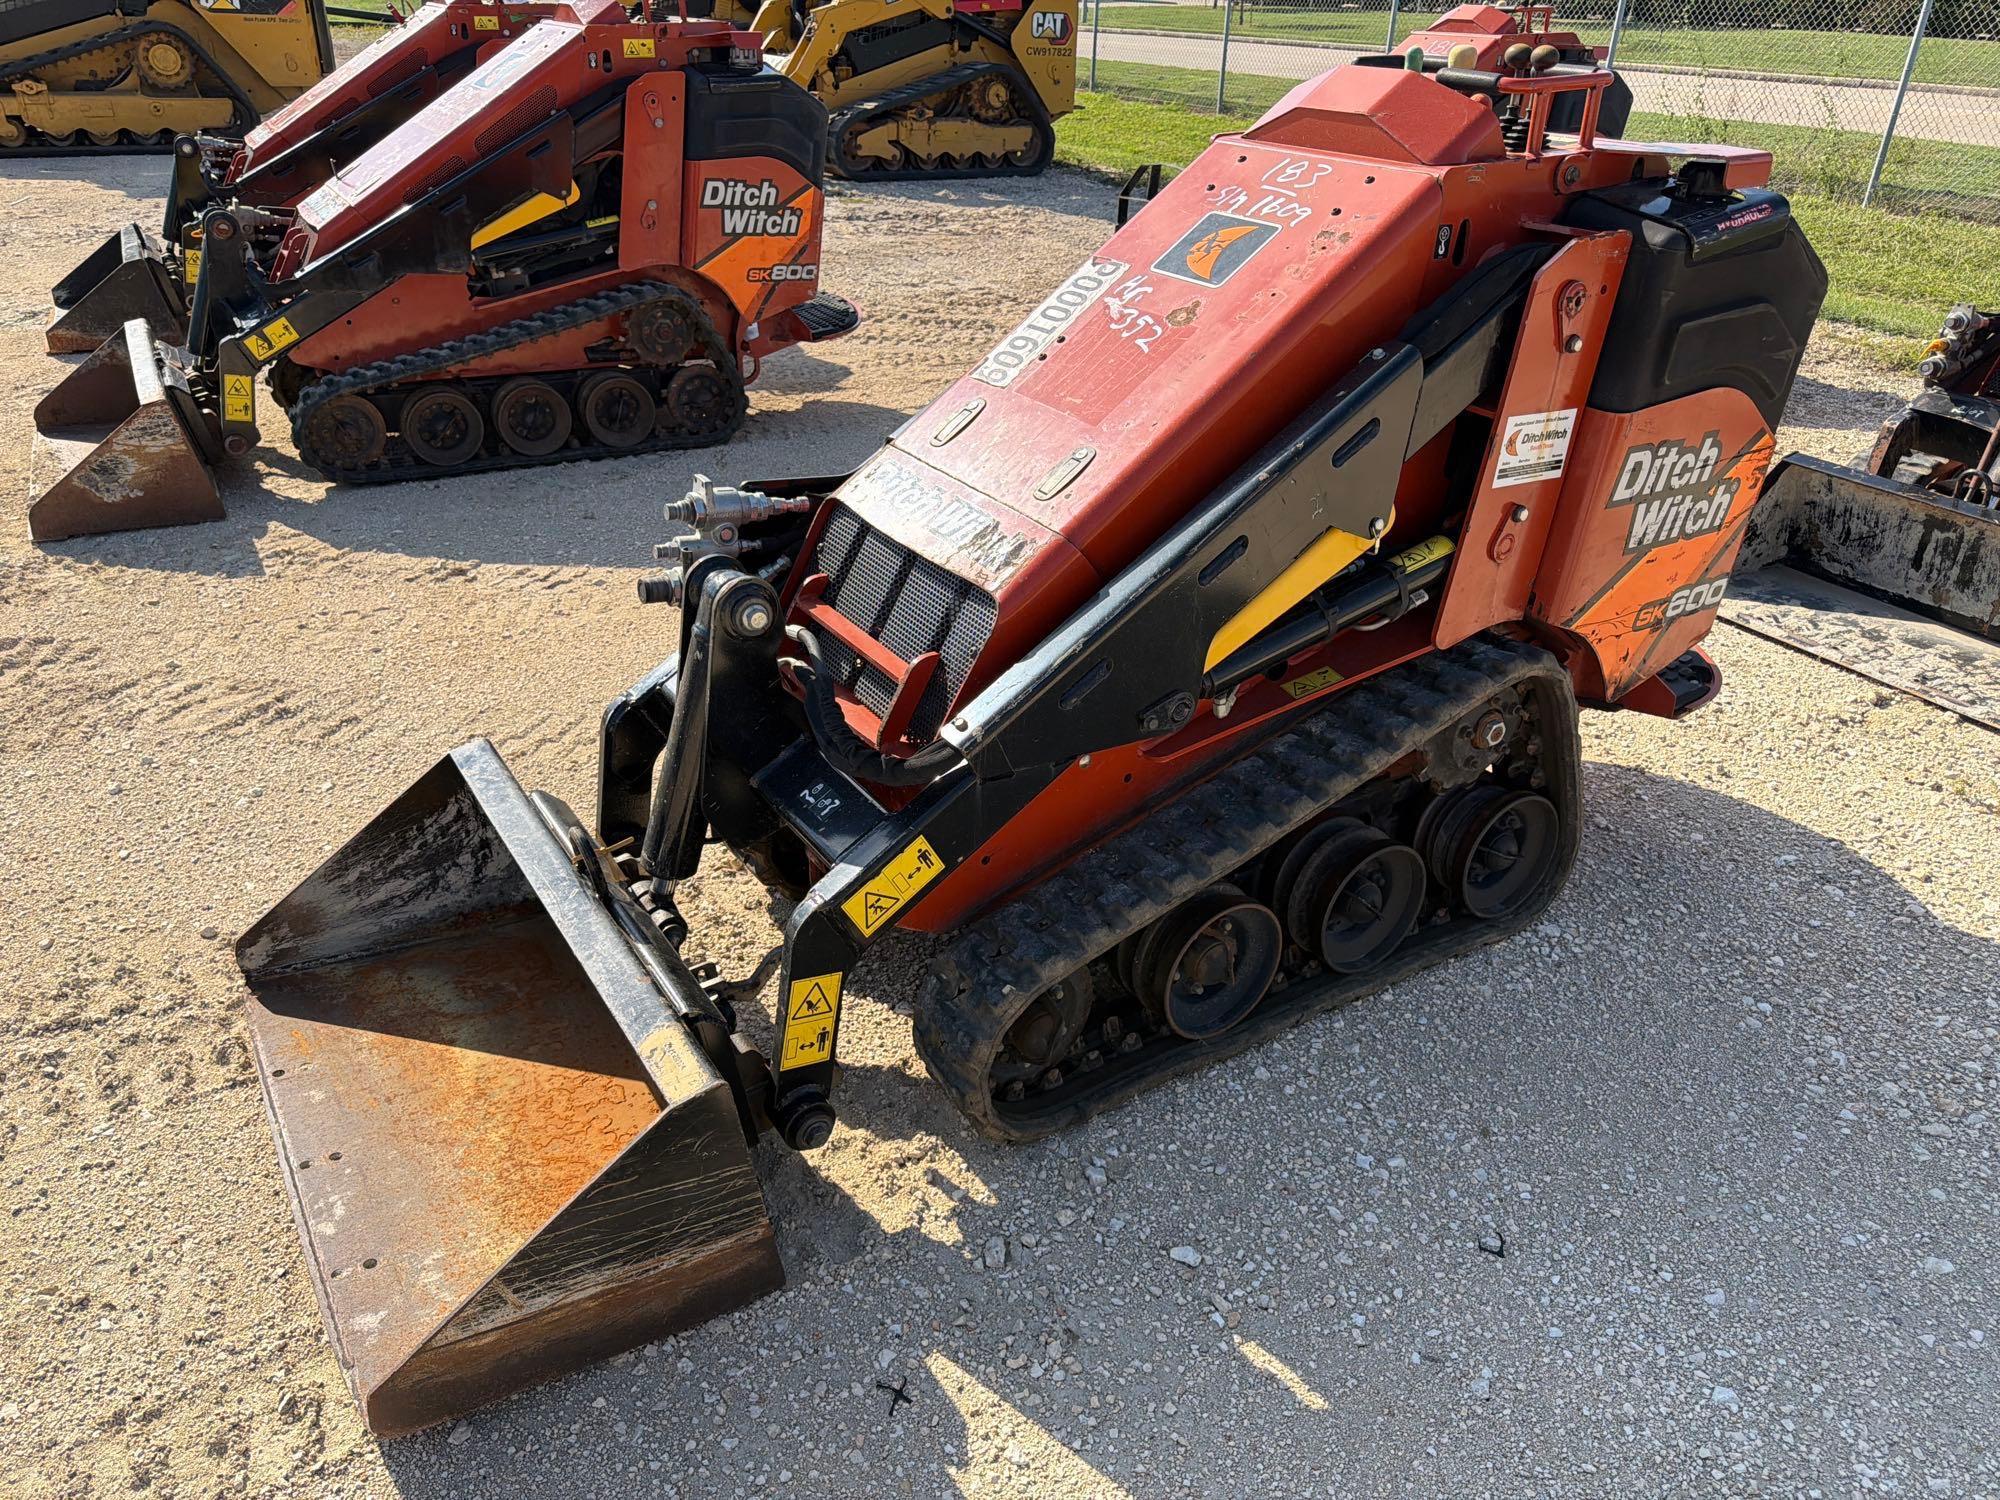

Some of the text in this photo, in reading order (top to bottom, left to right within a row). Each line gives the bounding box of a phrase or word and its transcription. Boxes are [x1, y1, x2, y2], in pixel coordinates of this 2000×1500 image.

[1033, 12, 1064, 37] CAT
[1026, 47, 1073, 57] CW917822
[1261, 158, 1333, 188] 183
[703, 180, 777, 206] Ditch
[723, 209, 799, 234] Witch
[1245, 194, 1313, 227] 1609
[748, 265, 817, 281] SK800
[1612, 437, 1720, 502] Ditch
[1628, 484, 1731, 549] Witch
